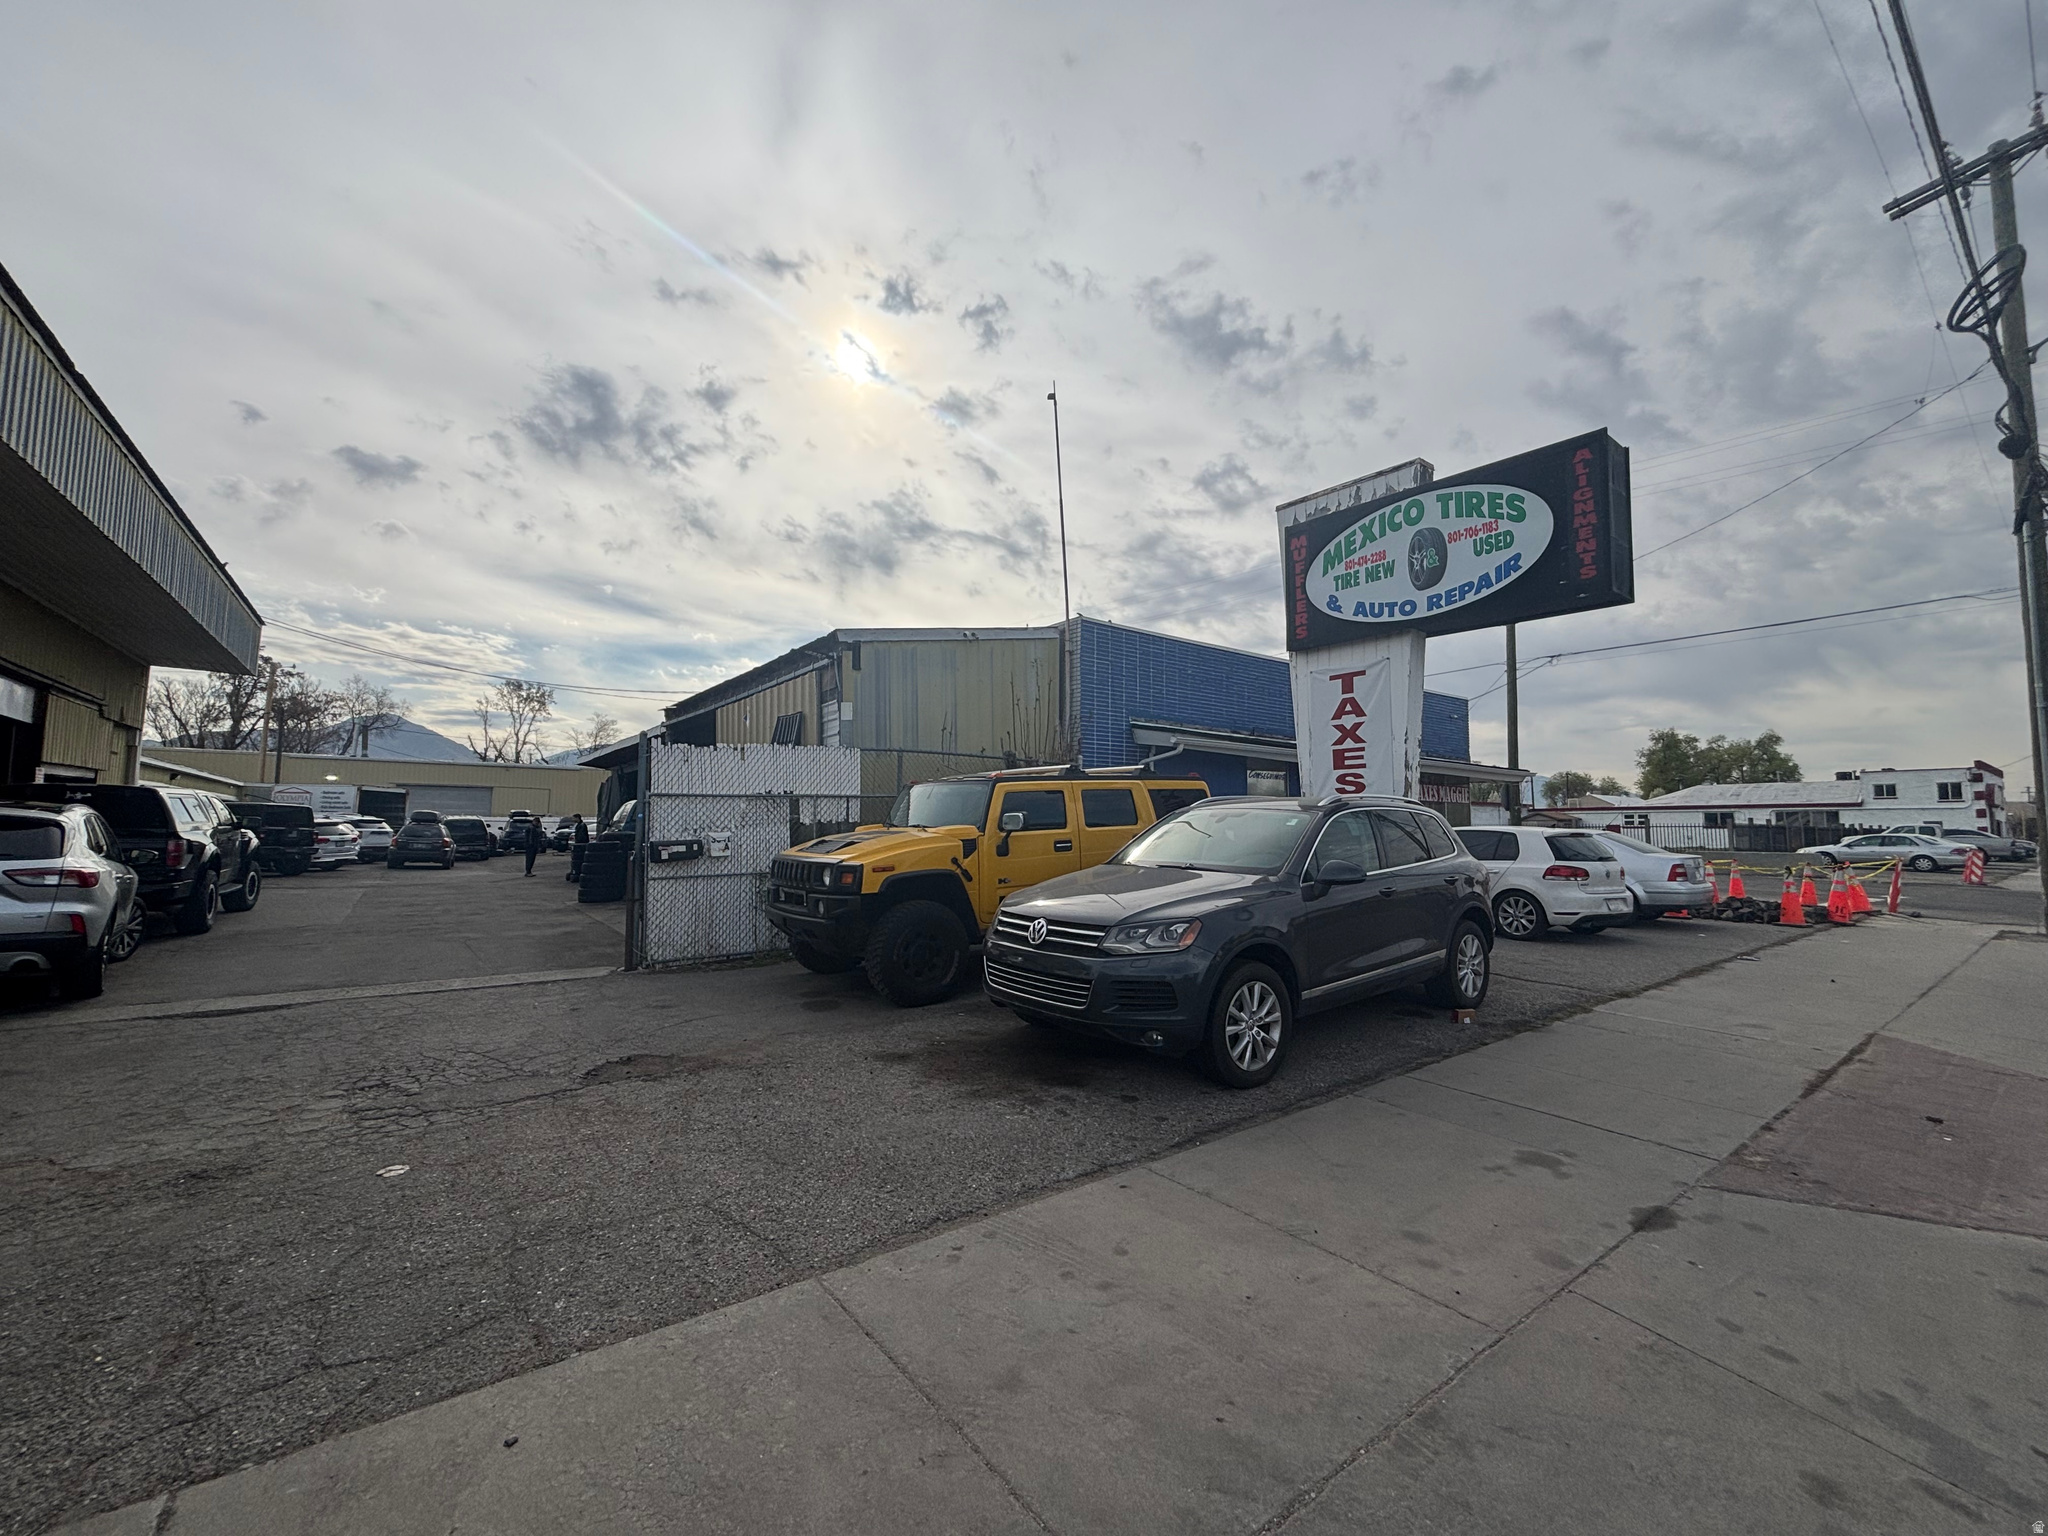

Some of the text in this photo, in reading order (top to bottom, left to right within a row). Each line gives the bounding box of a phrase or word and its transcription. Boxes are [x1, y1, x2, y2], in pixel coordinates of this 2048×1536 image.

[1322, 491, 1527, 578] MEXICO TIRES
[1447, 519, 1499, 544] 801-706-1183
[1572, 448, 1598, 579] ALIGNMENTS
[1290, 535, 1308, 639] MUFFLERS
[1326, 552, 1522, 618] & AUTO REPAIR
[1333, 530, 1515, 592] TIRE NEW & USED
[1329, 670, 1367, 794] TAXES
[276, 794, 309, 802] OLYMPIA
[1419, 784, 1470, 803] AXES MAGGIE
